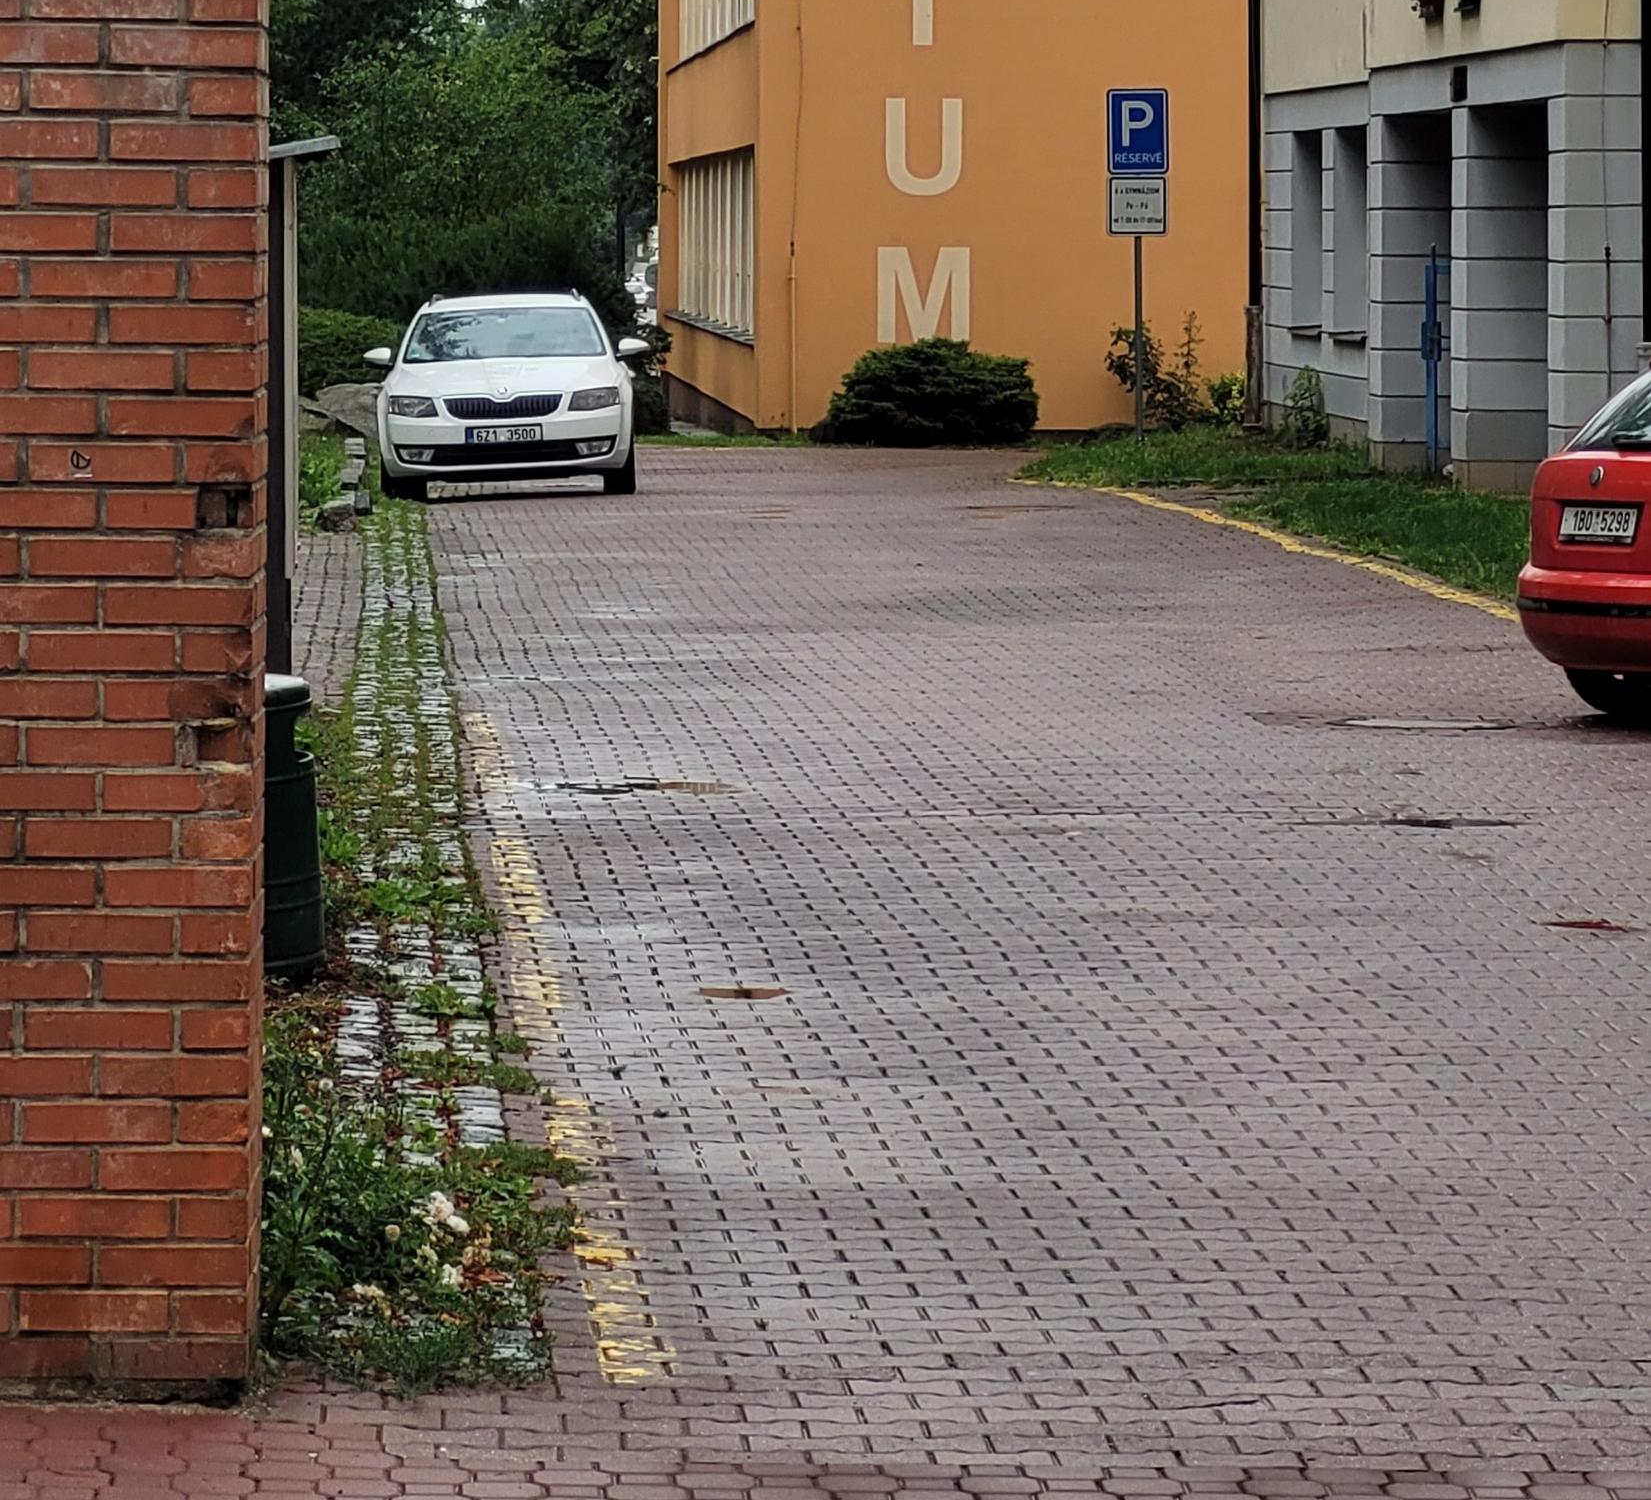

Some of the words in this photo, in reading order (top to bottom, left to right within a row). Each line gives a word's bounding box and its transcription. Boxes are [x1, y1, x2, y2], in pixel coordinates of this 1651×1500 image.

[1121, 100, 1154, 147] P
[476, 429, 497, 442] 6Z1
[506, 428, 536, 441] 3500
[1573, 509, 1593, 532] 1B0
[1600, 510, 1631, 533] 5298
